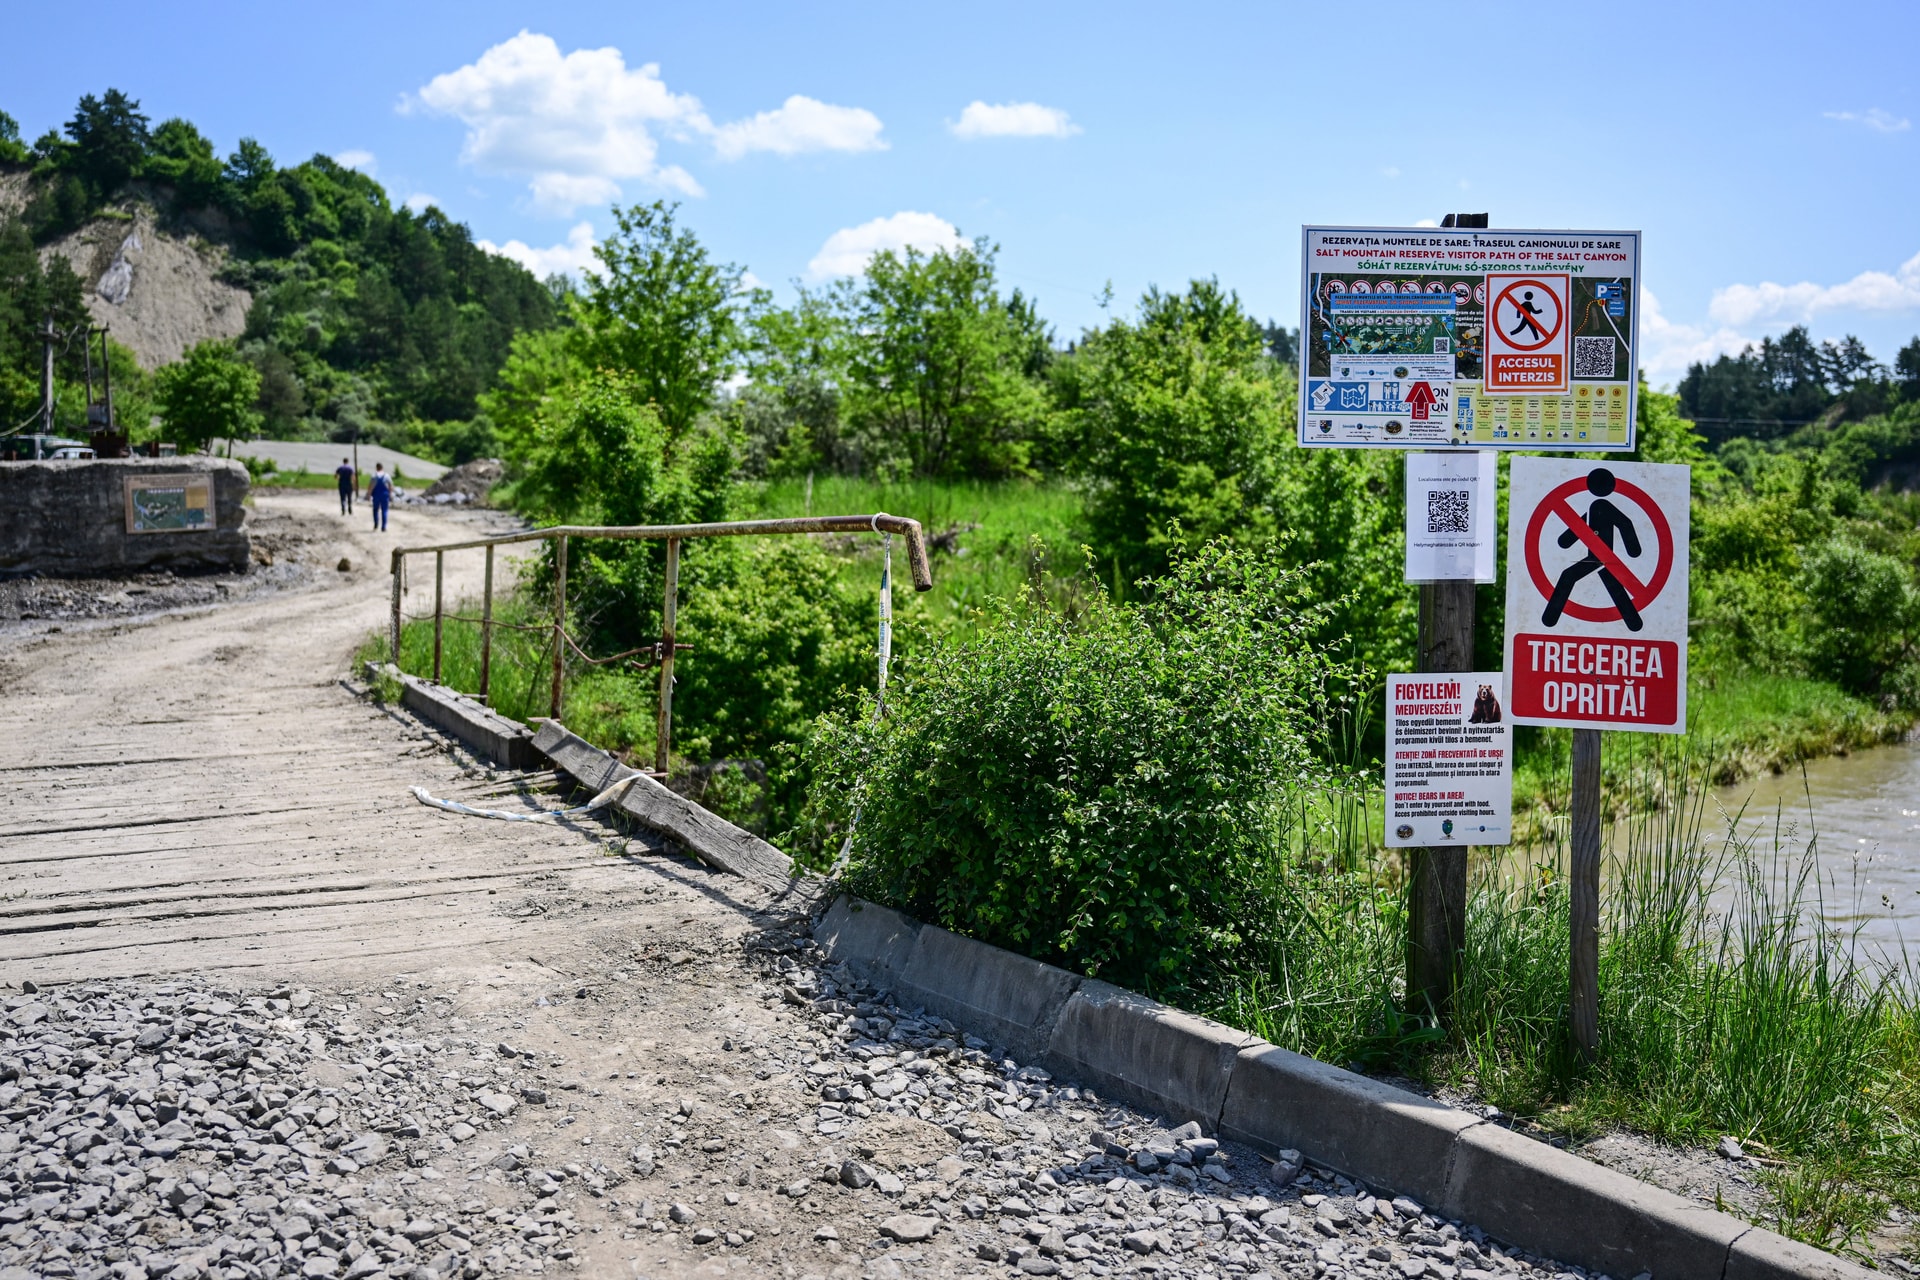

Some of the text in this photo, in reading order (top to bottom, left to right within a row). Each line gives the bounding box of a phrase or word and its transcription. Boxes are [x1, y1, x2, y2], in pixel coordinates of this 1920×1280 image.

[1322, 237, 1380, 247] REZERVAȚIA
[1519, 240, 1578, 248] CANIONULUI
[1358, 260, 1391, 270] SÓHÁT
[1394, 261, 1462, 271] REZERVÁTUM:
[1498, 357, 1556, 369] ACCESUL
[1498, 370, 1555, 383] INTERZIS
[1528, 640, 1664, 679] TRECEREA
[1395, 683, 1461, 700] FIGYELEM!
[1543, 679, 1646, 717] OPRITĂ!
[1395, 702, 1461, 716] MEDVEVESZÉLY!
[1411, 718, 1434, 727] egyedül
[1395, 751, 1420, 761] ATENȚIE!
[1421, 749, 1436, 758] ZONĂ
[1438, 748, 1477, 758] FRECVENTATĂ
[1488, 750, 1503, 760] URȘI!
[1395, 792, 1417, 800] NOTICE!
